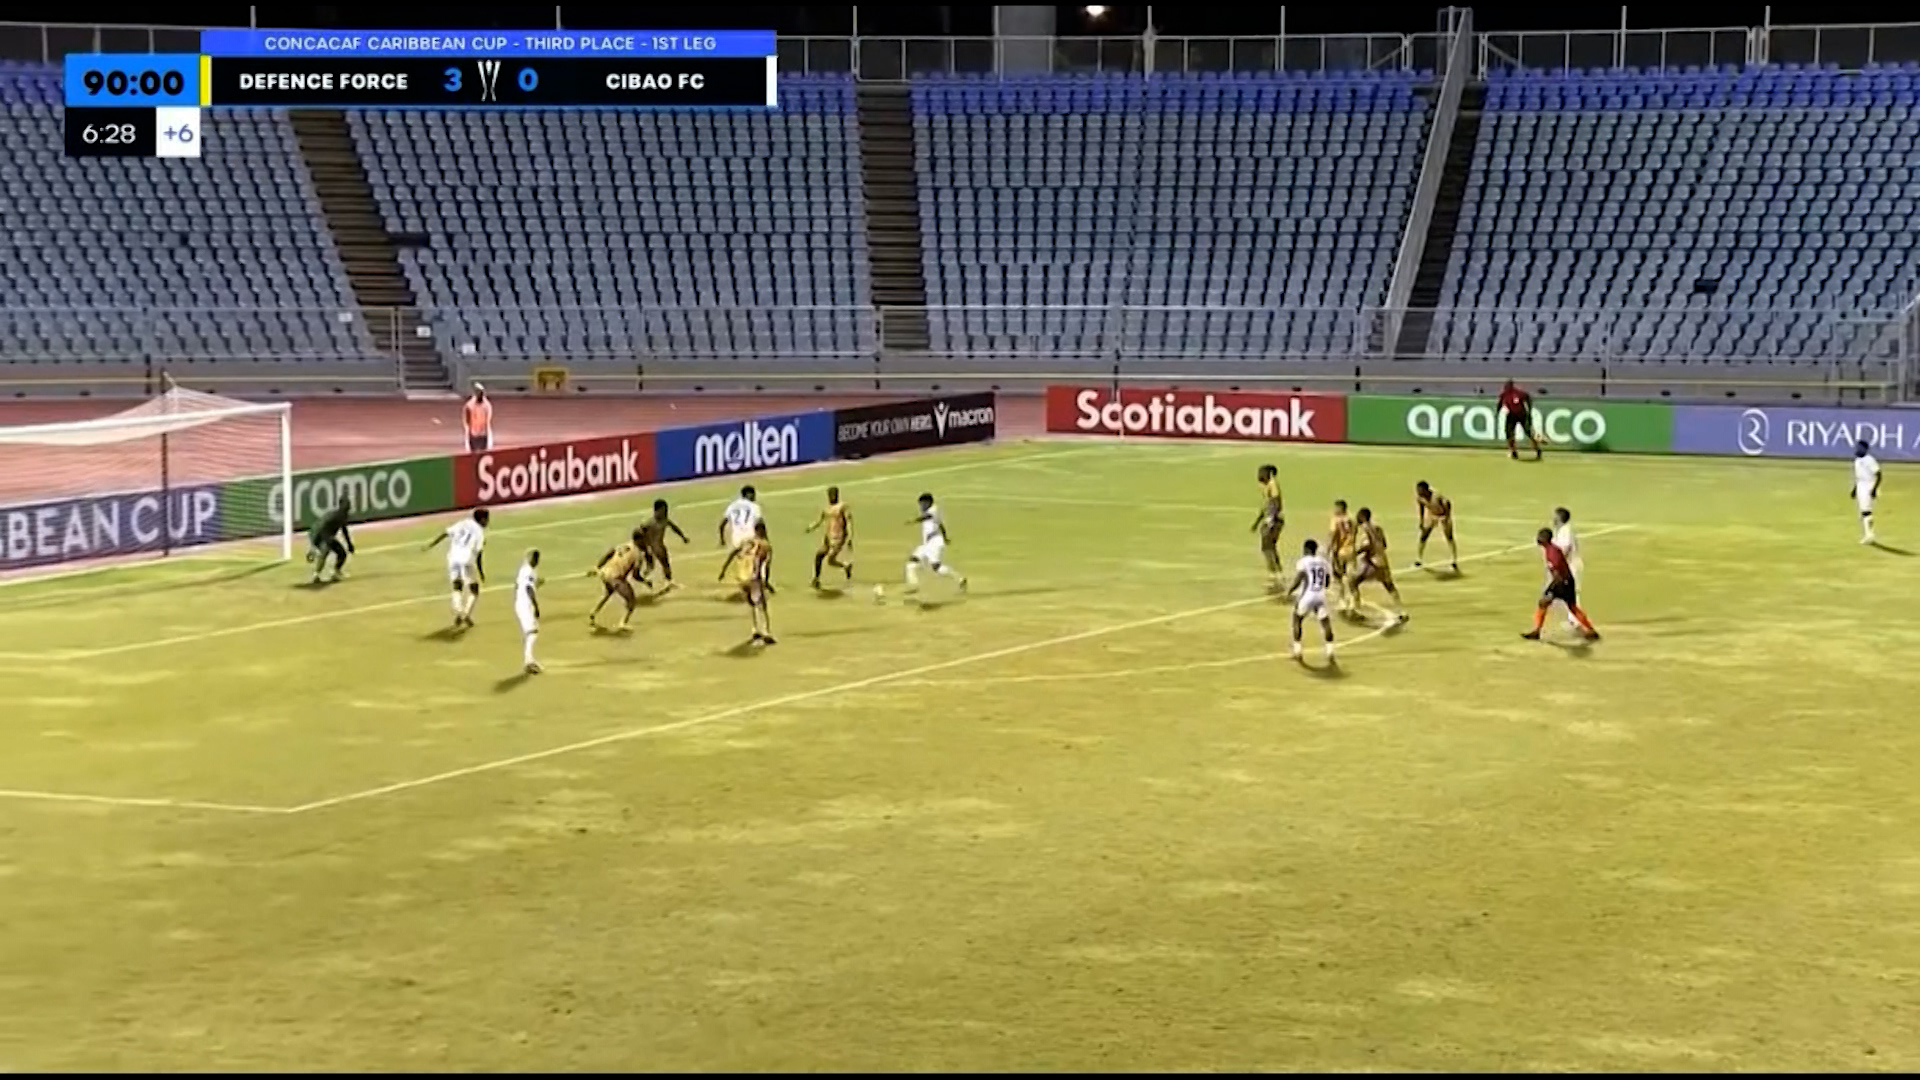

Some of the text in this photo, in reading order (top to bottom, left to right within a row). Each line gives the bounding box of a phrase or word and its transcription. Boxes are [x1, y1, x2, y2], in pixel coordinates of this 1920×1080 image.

[949, 407, 994, 428] macron
[1075, 389, 1316, 438] Scotiabank
[1406, 403, 1606, 444] aramco
[1786, 420, 1903, 449] RIYADH
[477, 440, 639, 501] Scotiabank
[695, 420, 799, 474] molten
[267, 469, 411, 523] aramco
[0, 490, 217, 559] BEAN CUP
[1310, 567, 1325, 586] 19
